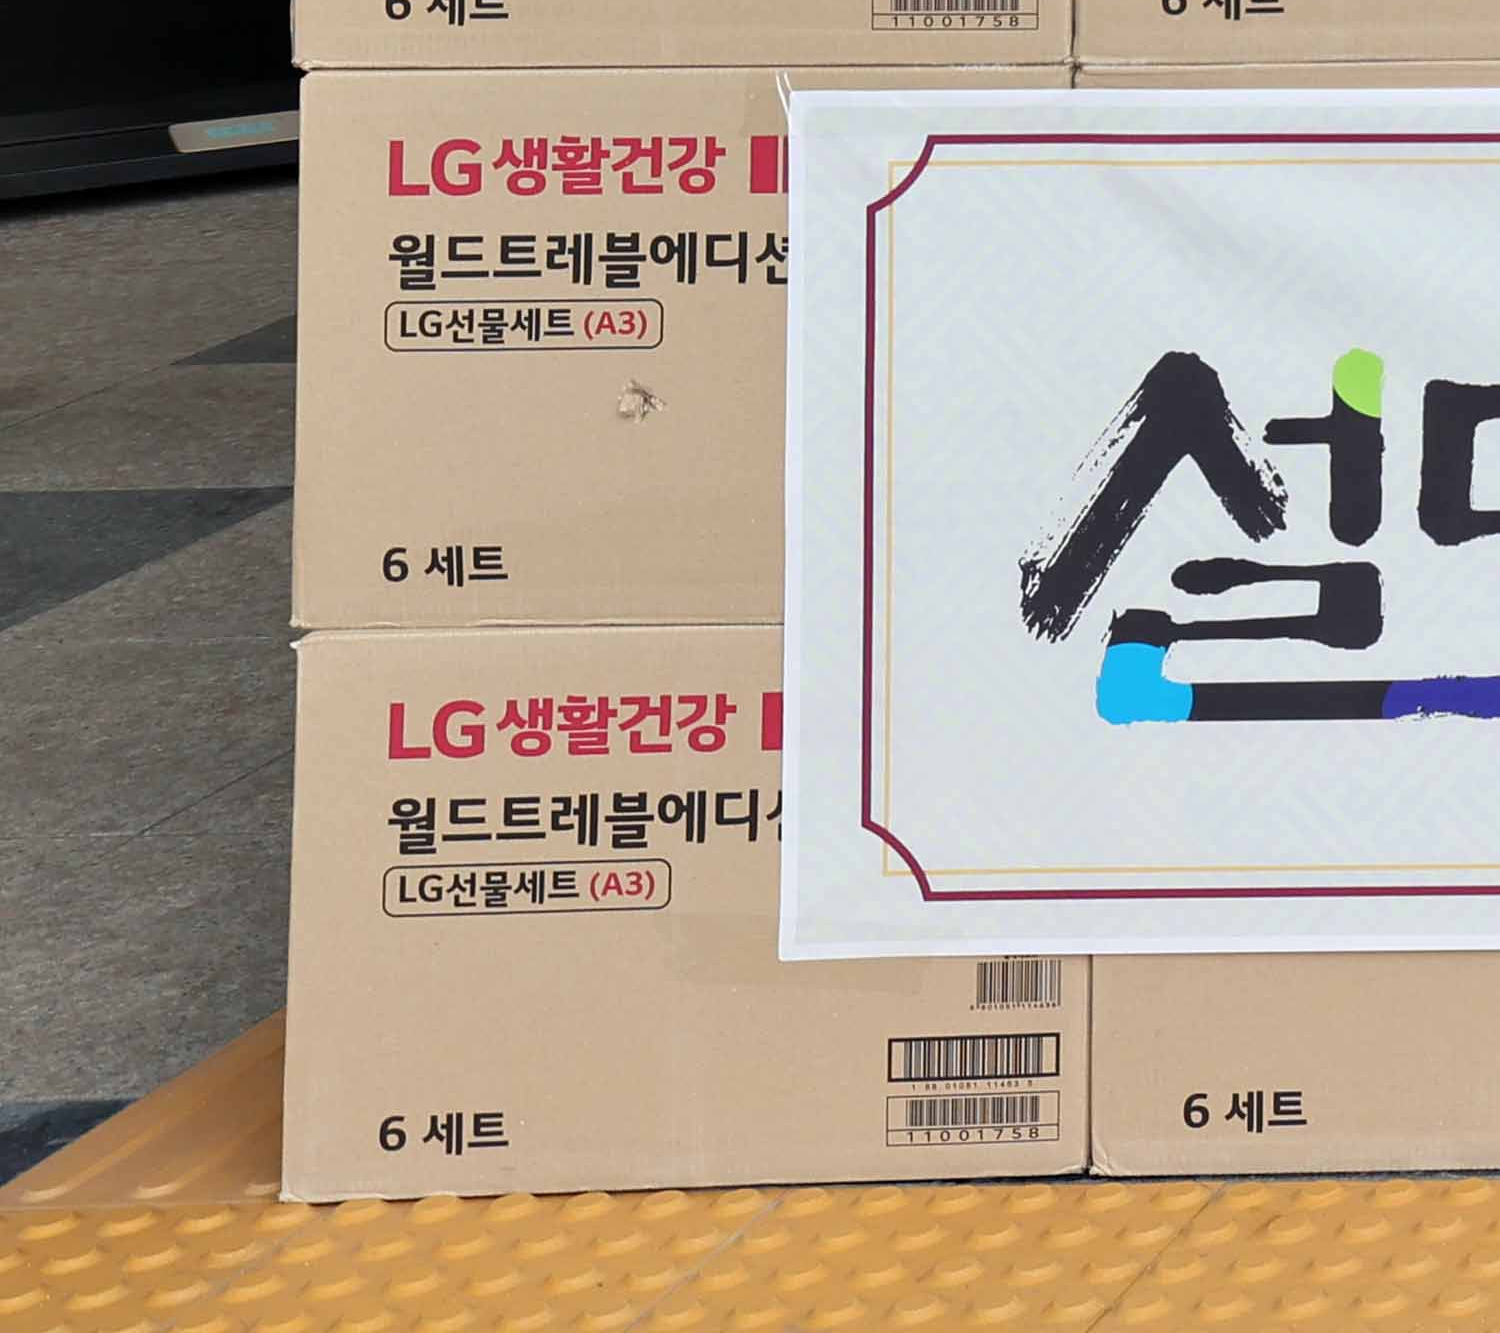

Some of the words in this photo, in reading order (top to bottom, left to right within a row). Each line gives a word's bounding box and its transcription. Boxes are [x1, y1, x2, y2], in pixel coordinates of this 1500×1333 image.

[890, 14, 1021, 30] 11001758
[389, 135, 726, 197] LG생활건강
[400, 308, 575, 344] LG선물세트
[584, 310, 647, 340] (A3)
[383, 547, 409, 582] 6
[424, 545, 508, 587] 세트
[388, 693, 737, 759] LG생활건강
[399, 869, 580, 908] LG선물세트
[590, 870, 655, 901] (A3)
[379, 1116, 406, 1151] 6
[422, 1112, 509, 1156] 세트
[905, 1126, 1040, 1143] 11001758
